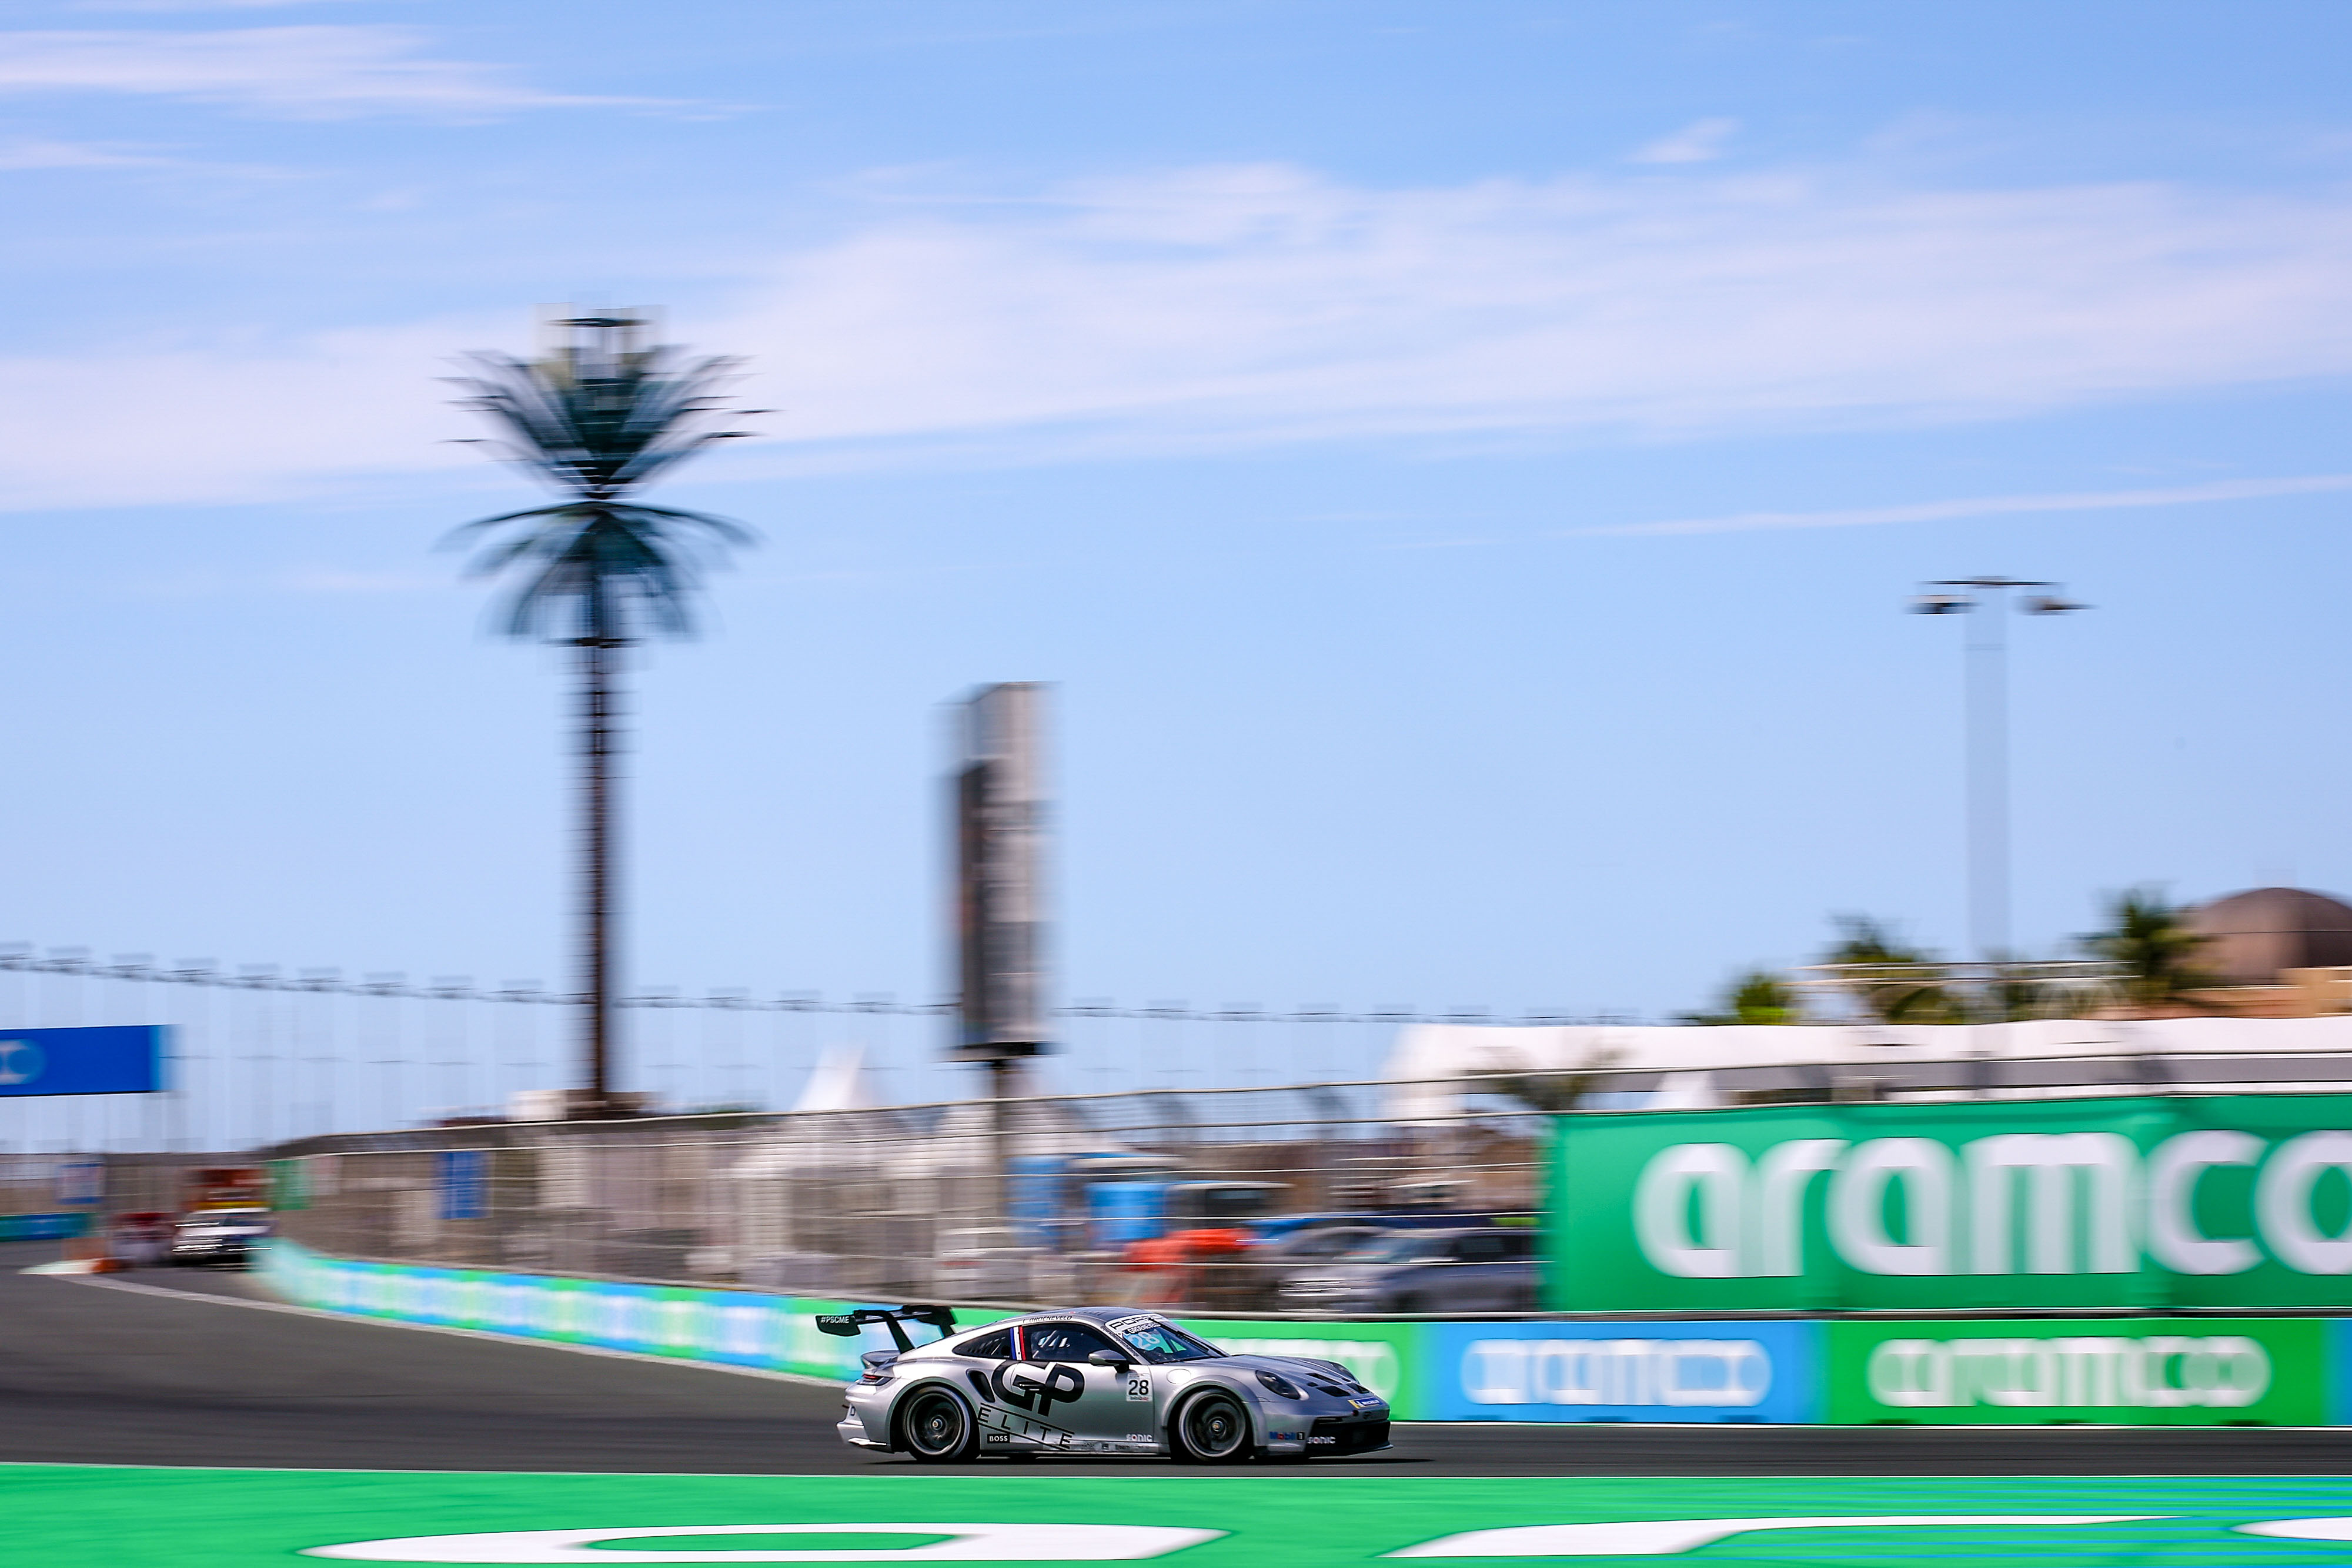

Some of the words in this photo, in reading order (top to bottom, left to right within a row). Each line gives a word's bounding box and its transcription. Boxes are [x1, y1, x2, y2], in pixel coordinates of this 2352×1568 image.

[1632, 1130, 2352, 1278] aramco
[1129, 1331, 1161, 1348] 28
[991, 1359, 1085, 1417] GP
[1128, 1379, 1148, 1395] 28
[1866, 1336, 2271, 1407] aramco
[977, 1406, 1073, 1449] ELITE
